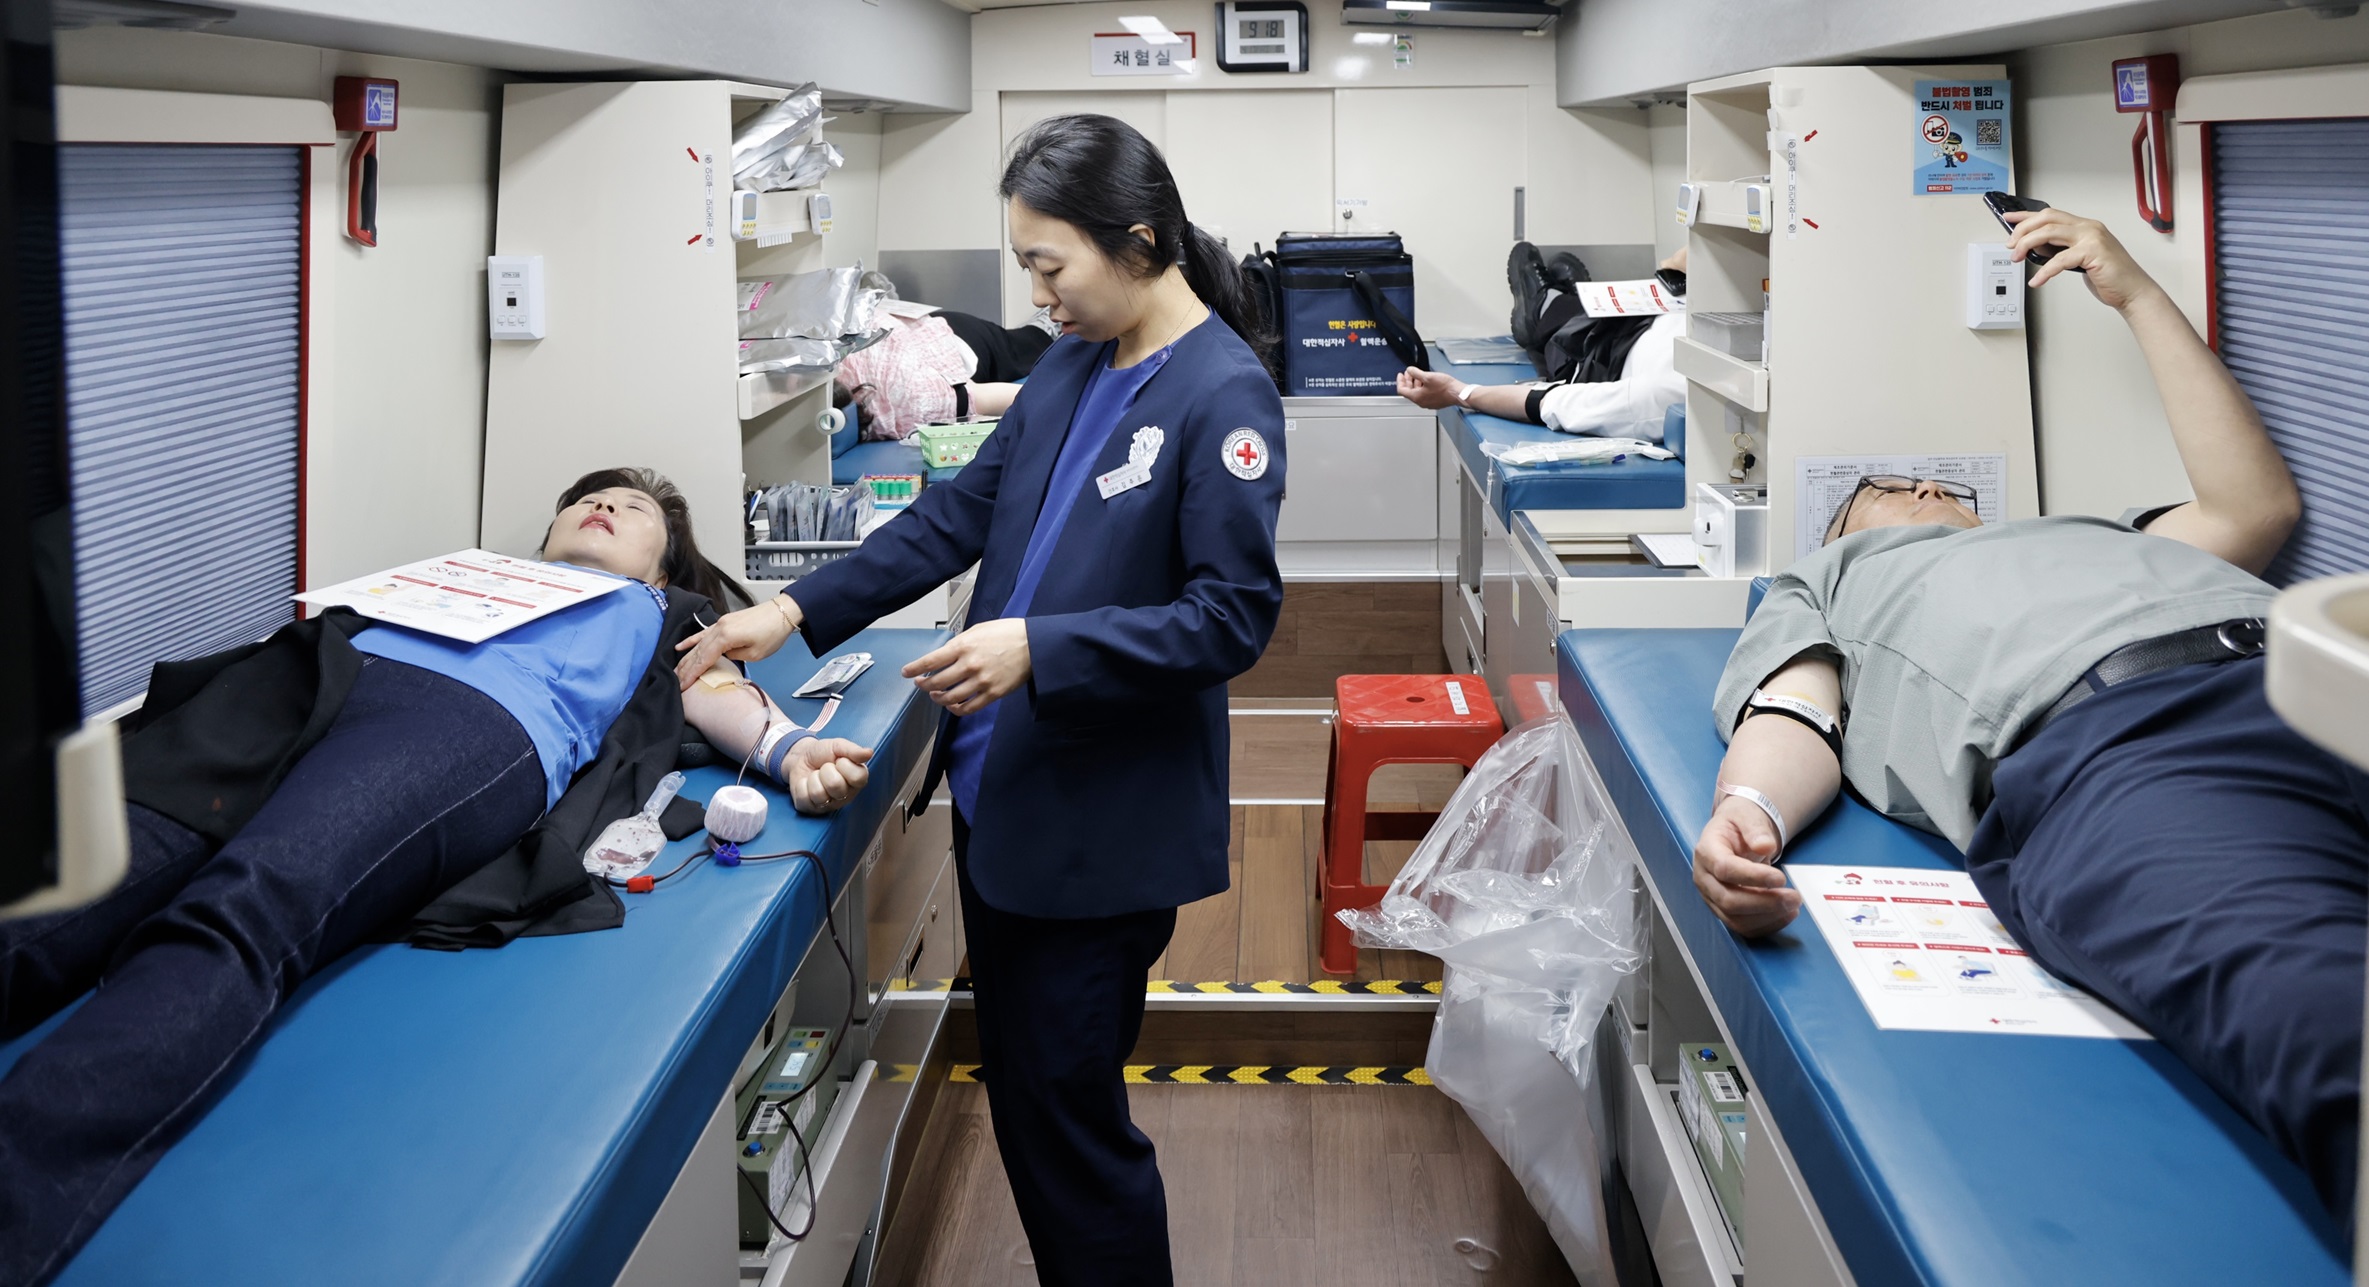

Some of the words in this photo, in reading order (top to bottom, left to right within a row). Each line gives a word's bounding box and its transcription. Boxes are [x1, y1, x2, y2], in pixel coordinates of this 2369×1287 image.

[1113, 48, 1171, 66] 채혈실
[1973, 86, 1993, 97] 범죄
[1921, 100, 1950, 112] 반드시
[1953, 100, 1972, 111] 처벌
[1974, 99, 2004, 111] 됩니다
[1302, 338, 1345, 347] 대한적십자사
[1225, 430, 1243, 452] KOREAN
[1243, 430, 1255, 438] RED
[1255, 437, 1266, 456] CROSS
[1230, 463, 1262, 478] 대한적십자사
